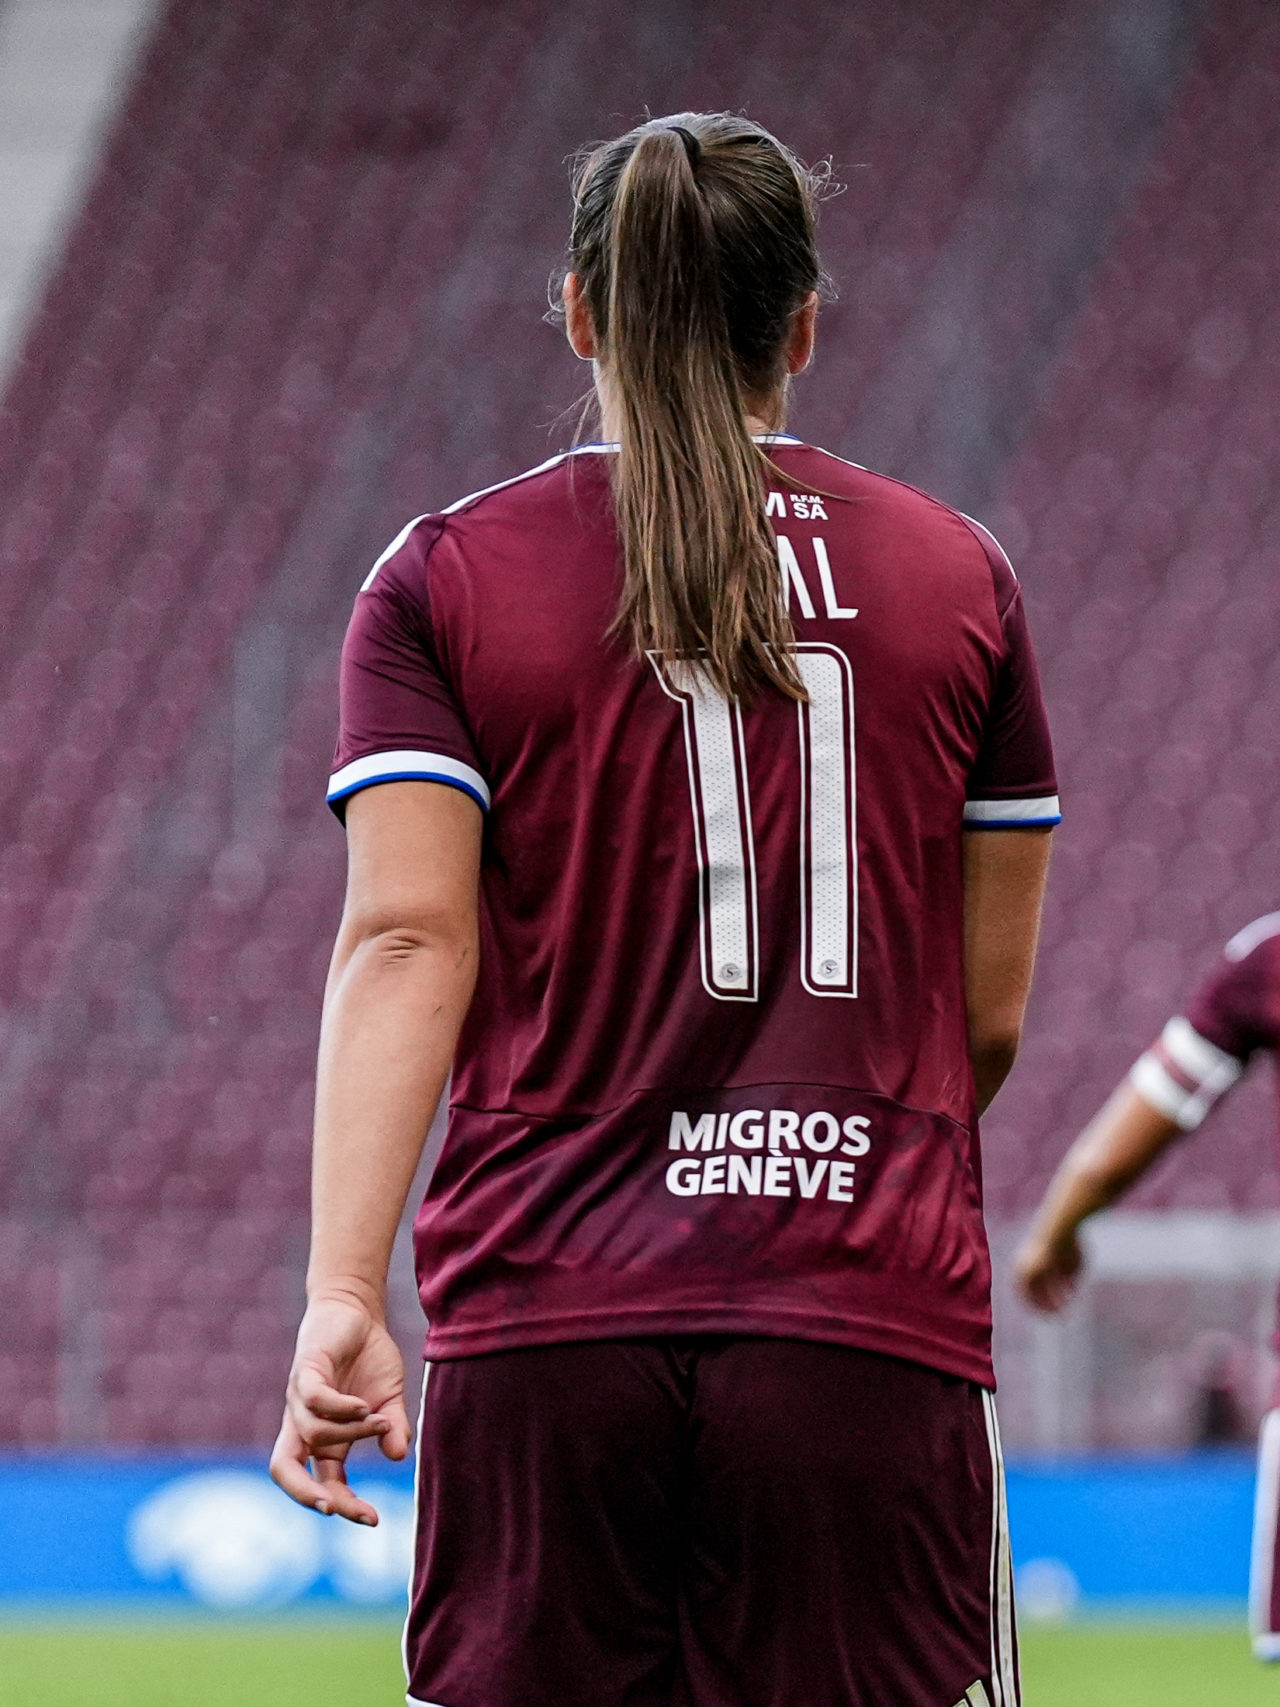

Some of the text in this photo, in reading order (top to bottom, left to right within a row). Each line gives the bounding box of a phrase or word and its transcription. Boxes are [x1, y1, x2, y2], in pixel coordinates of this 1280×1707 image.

[793, 502, 829, 520] SA
[777, 535, 859, 619] AL
[647, 641, 858, 1002] 11
[668, 1109, 871, 1157] MIGROS
[665, 1148, 856, 1203] GENÈVE
